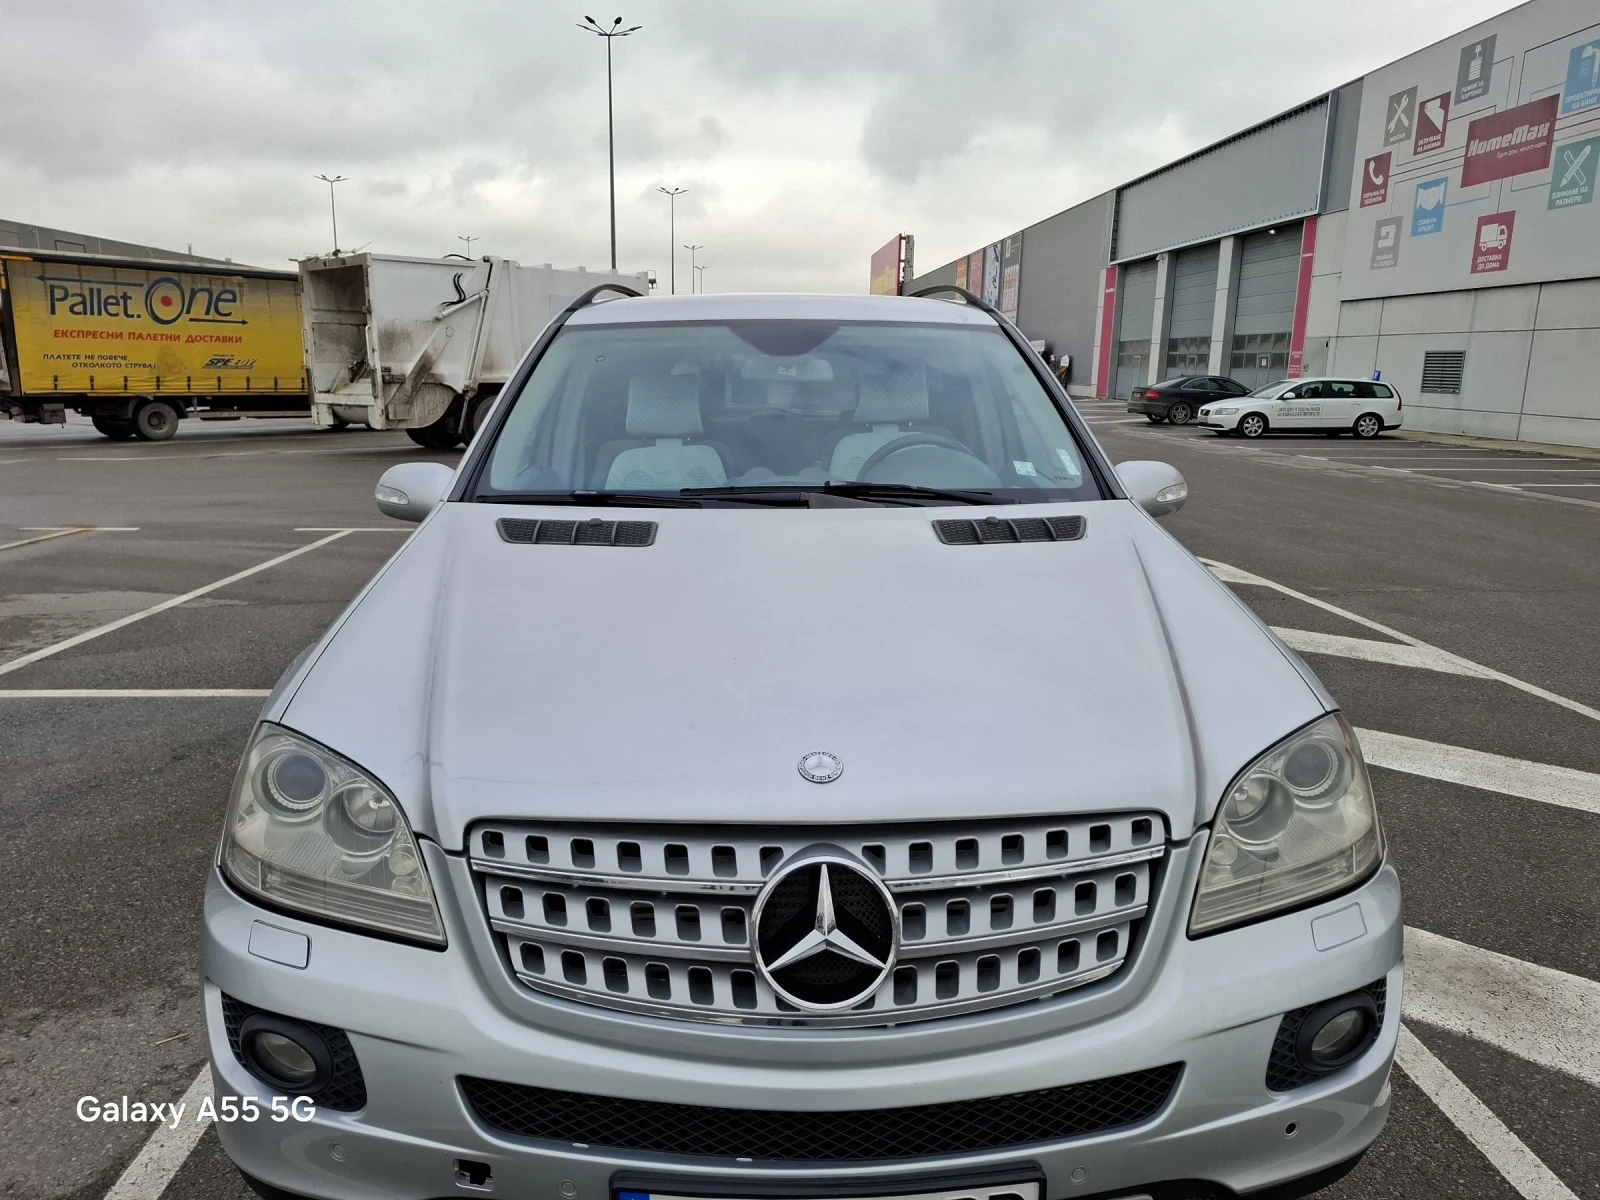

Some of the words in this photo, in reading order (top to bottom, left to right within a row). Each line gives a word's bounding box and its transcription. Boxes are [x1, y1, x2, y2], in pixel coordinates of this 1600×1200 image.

[1572, 101, 1580, 110] НА
[1467, 122, 1551, 157] HomeMax
[1551, 187, 1579, 199] ВЗИМАНЕ
[1579, 185, 1588, 194] НА
[1555, 195, 1582, 207] РАЗМЕРИ
[1477, 253, 1502, 264] ДОСТАВКА
[1477, 263, 1485, 271] ДО
[1485, 262, 1500, 270] ДОМА
[53, 329, 123, 340] ЕКСПРЕСНИ
[128, 331, 181, 342] ПАЛЕТНИ
[184, 333, 242, 344] ДОСТАВКИ
